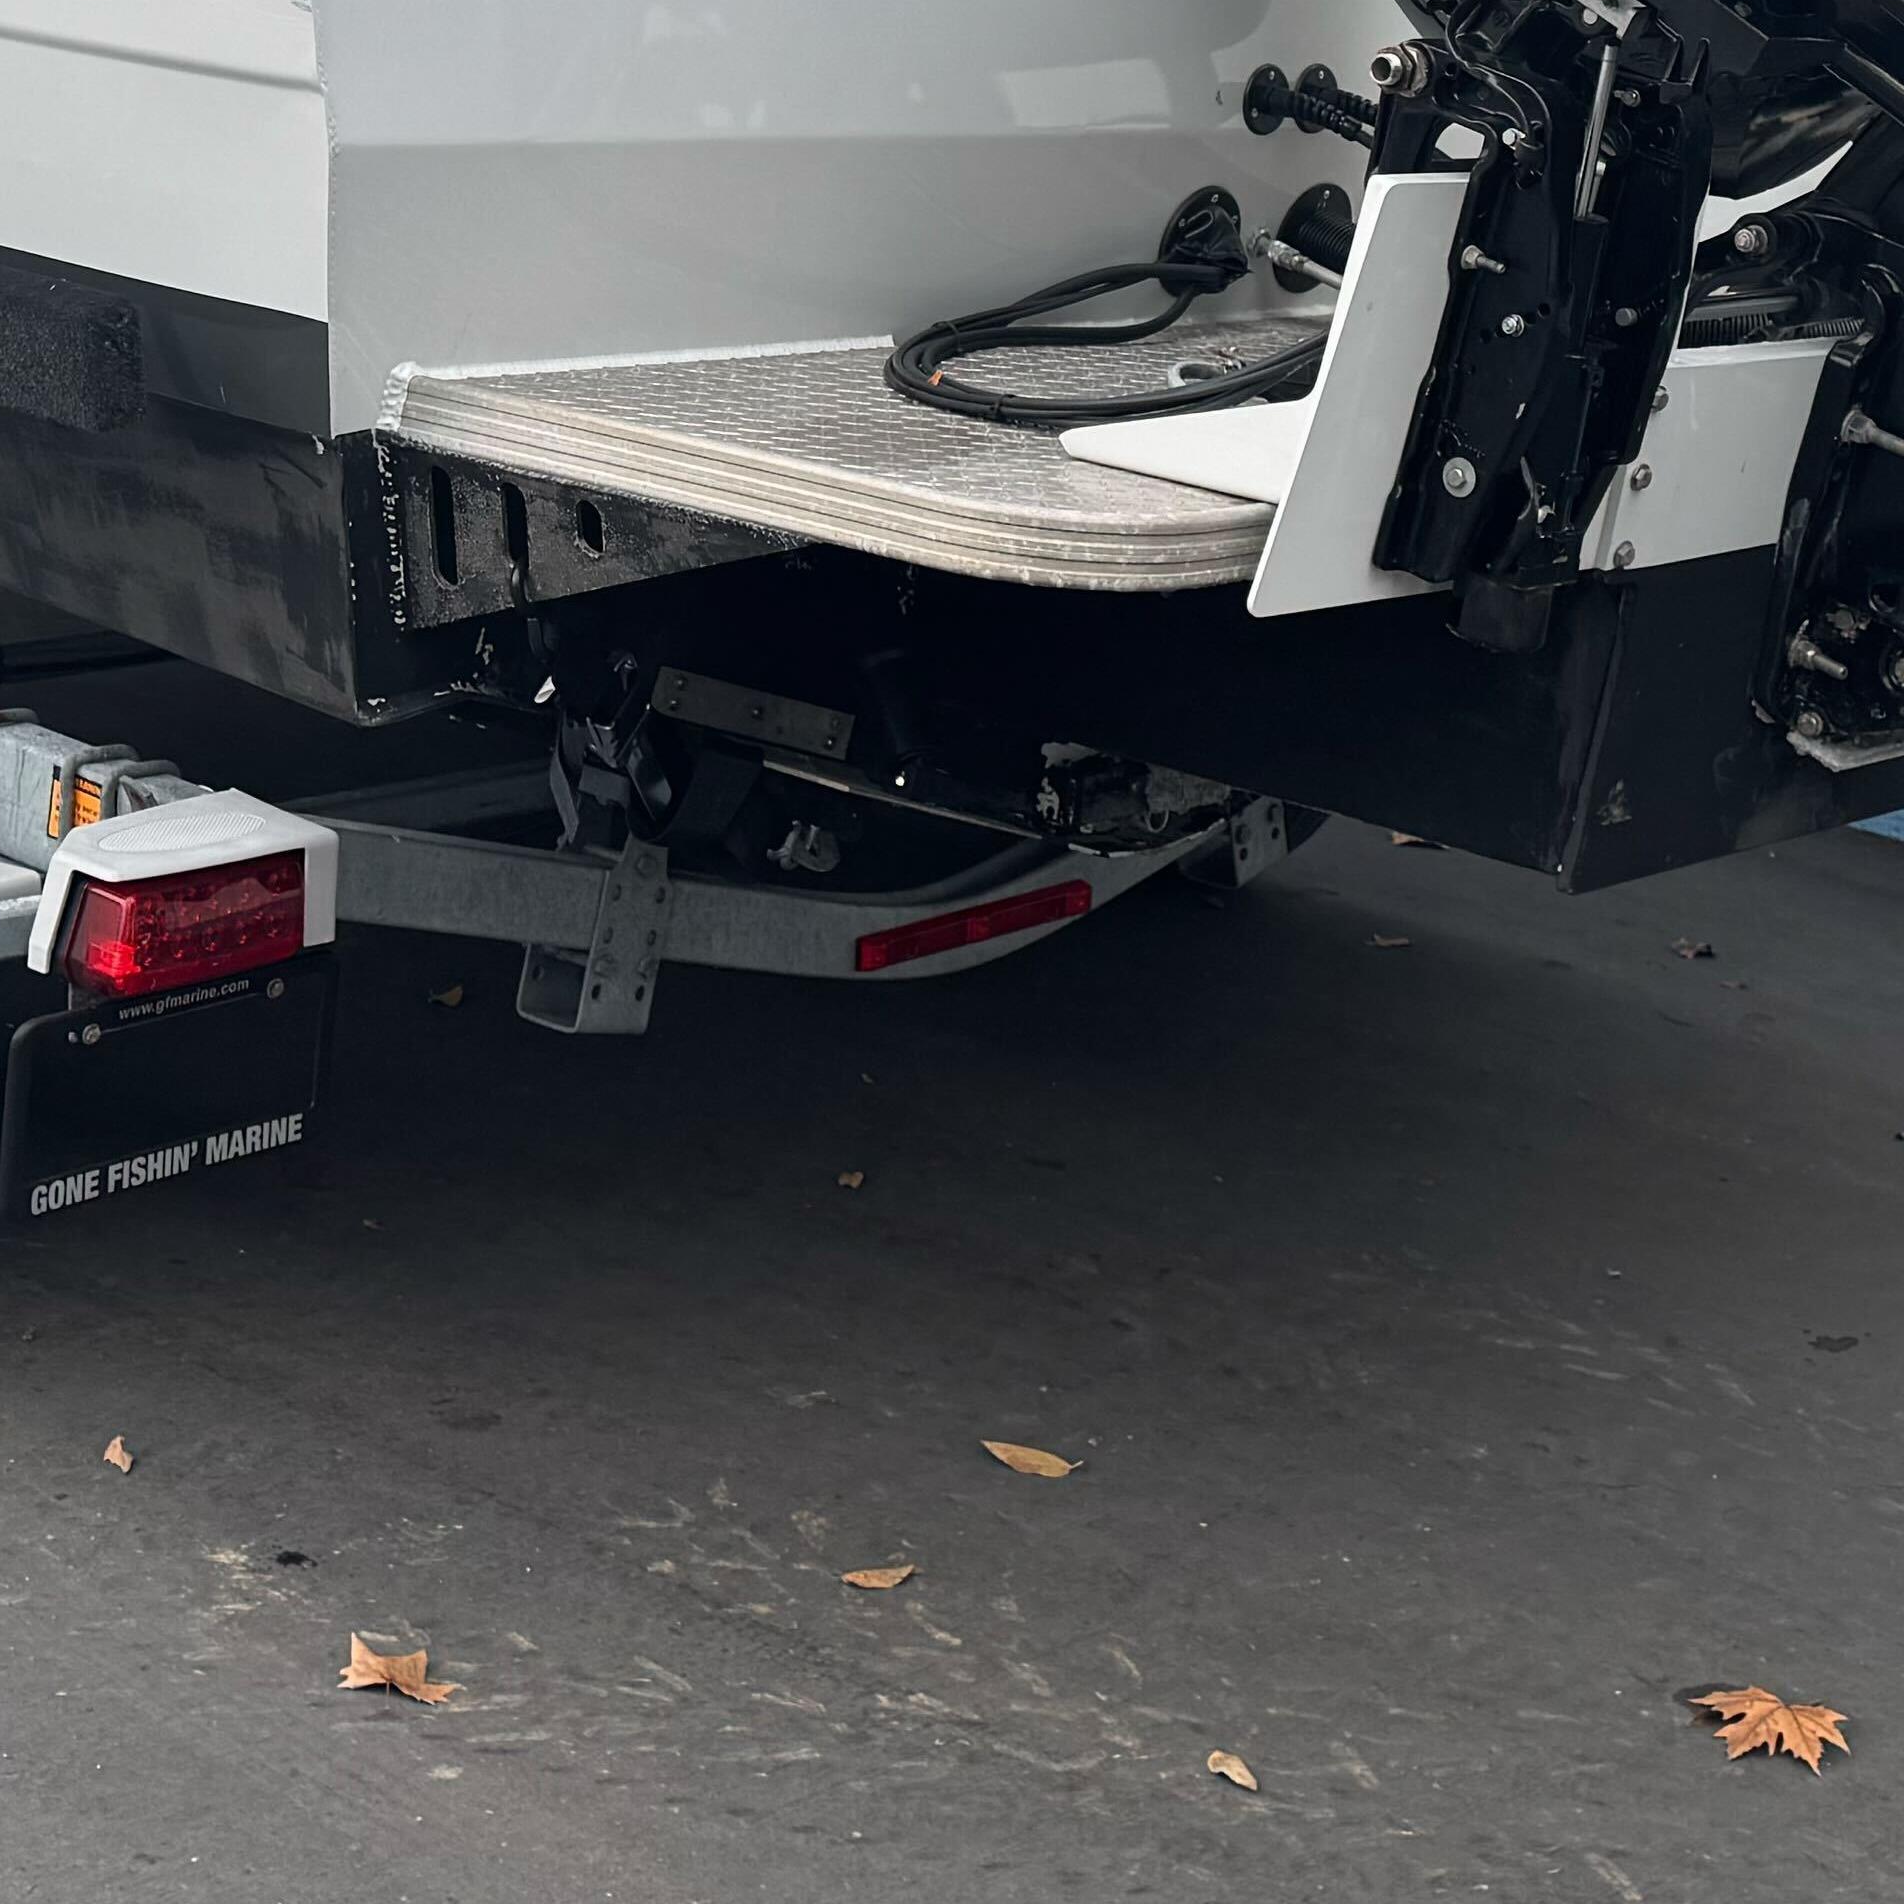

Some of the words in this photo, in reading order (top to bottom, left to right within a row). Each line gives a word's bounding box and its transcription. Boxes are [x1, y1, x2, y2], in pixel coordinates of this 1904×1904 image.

[118, 978, 250, 1021] www.gfmarine.com
[30, 1169, 100, 1216] GONE
[205, 1112, 303, 1166] MARINE
